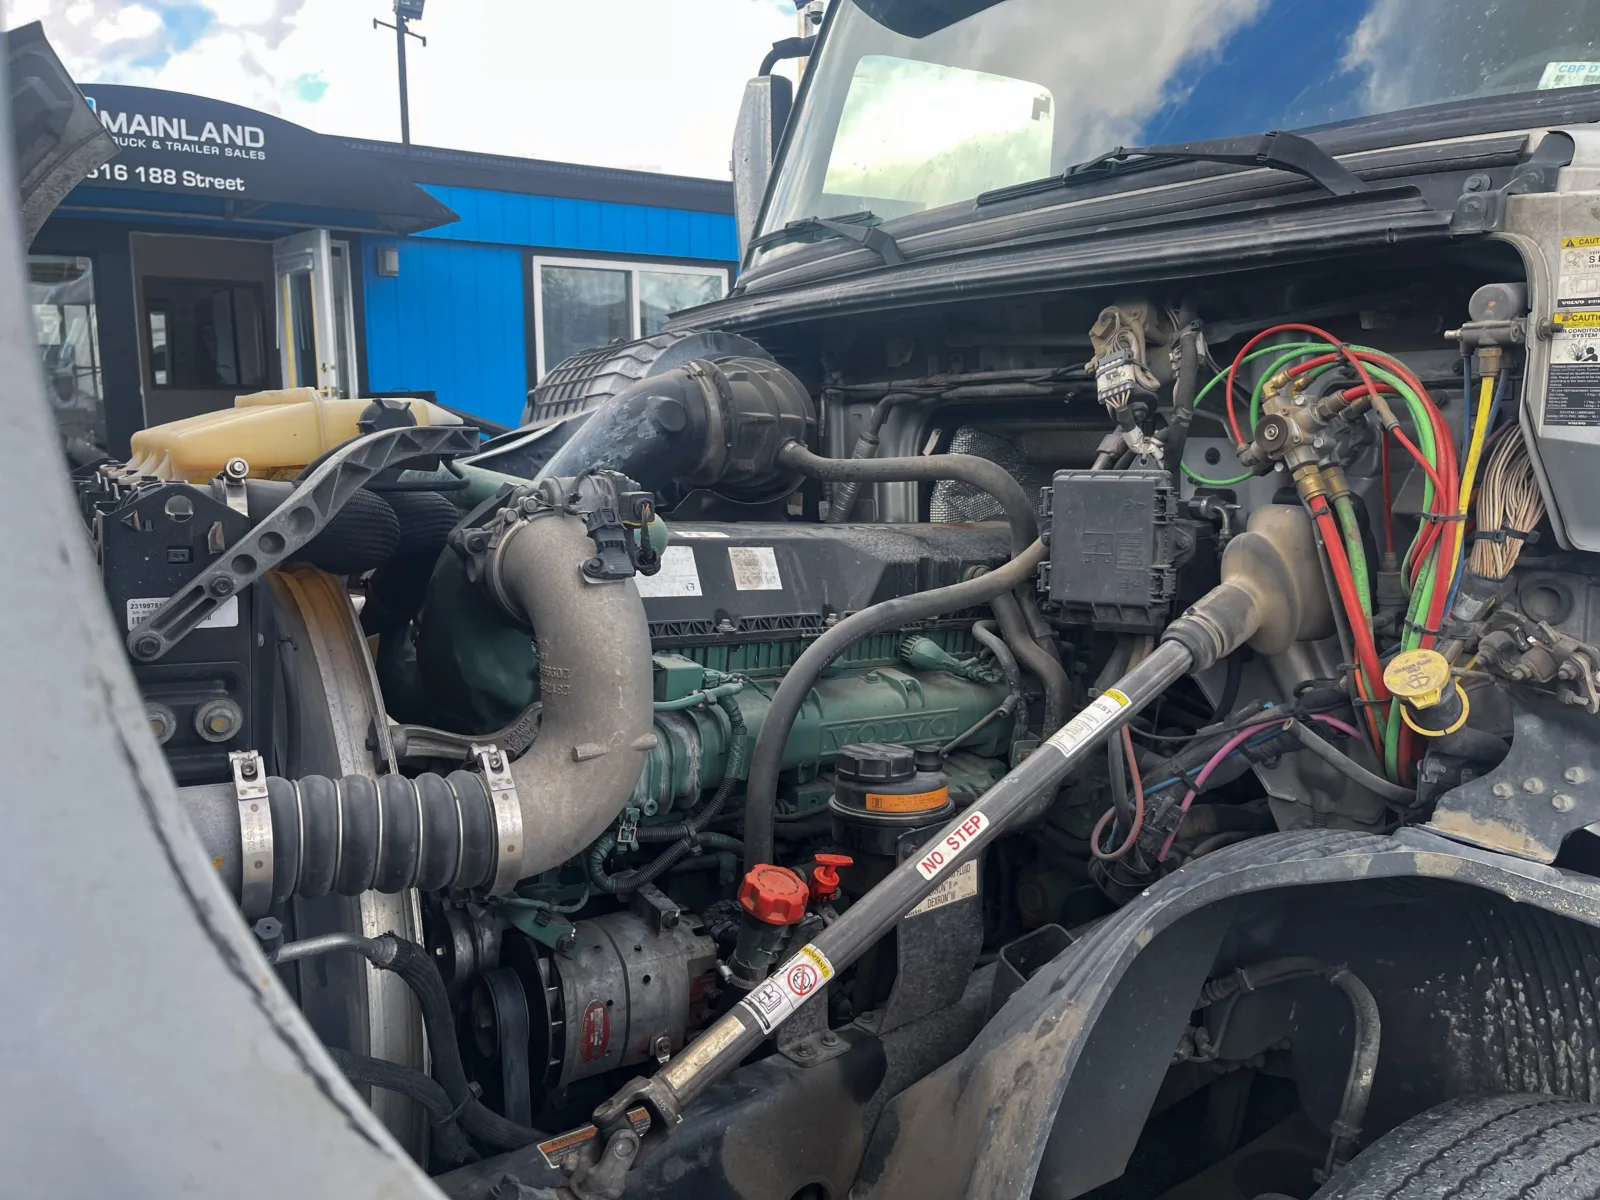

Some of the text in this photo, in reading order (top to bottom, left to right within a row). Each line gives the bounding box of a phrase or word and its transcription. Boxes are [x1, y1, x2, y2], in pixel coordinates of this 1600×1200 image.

[1558, 64, 1586, 73] CBP
[100, 110, 265, 148] MAINLAND
[152, 141, 162, 150] &
[166, 142, 220, 156] TRAILER
[225, 147, 266, 160] SALES
[135, 166, 177, 186] 188
[182, 171, 246, 192] Street
[1571, 314, 1600, 322] CAUTI
[826, 714, 950, 751] VOLVO
[921, 815, 981, 874] NO STEP
